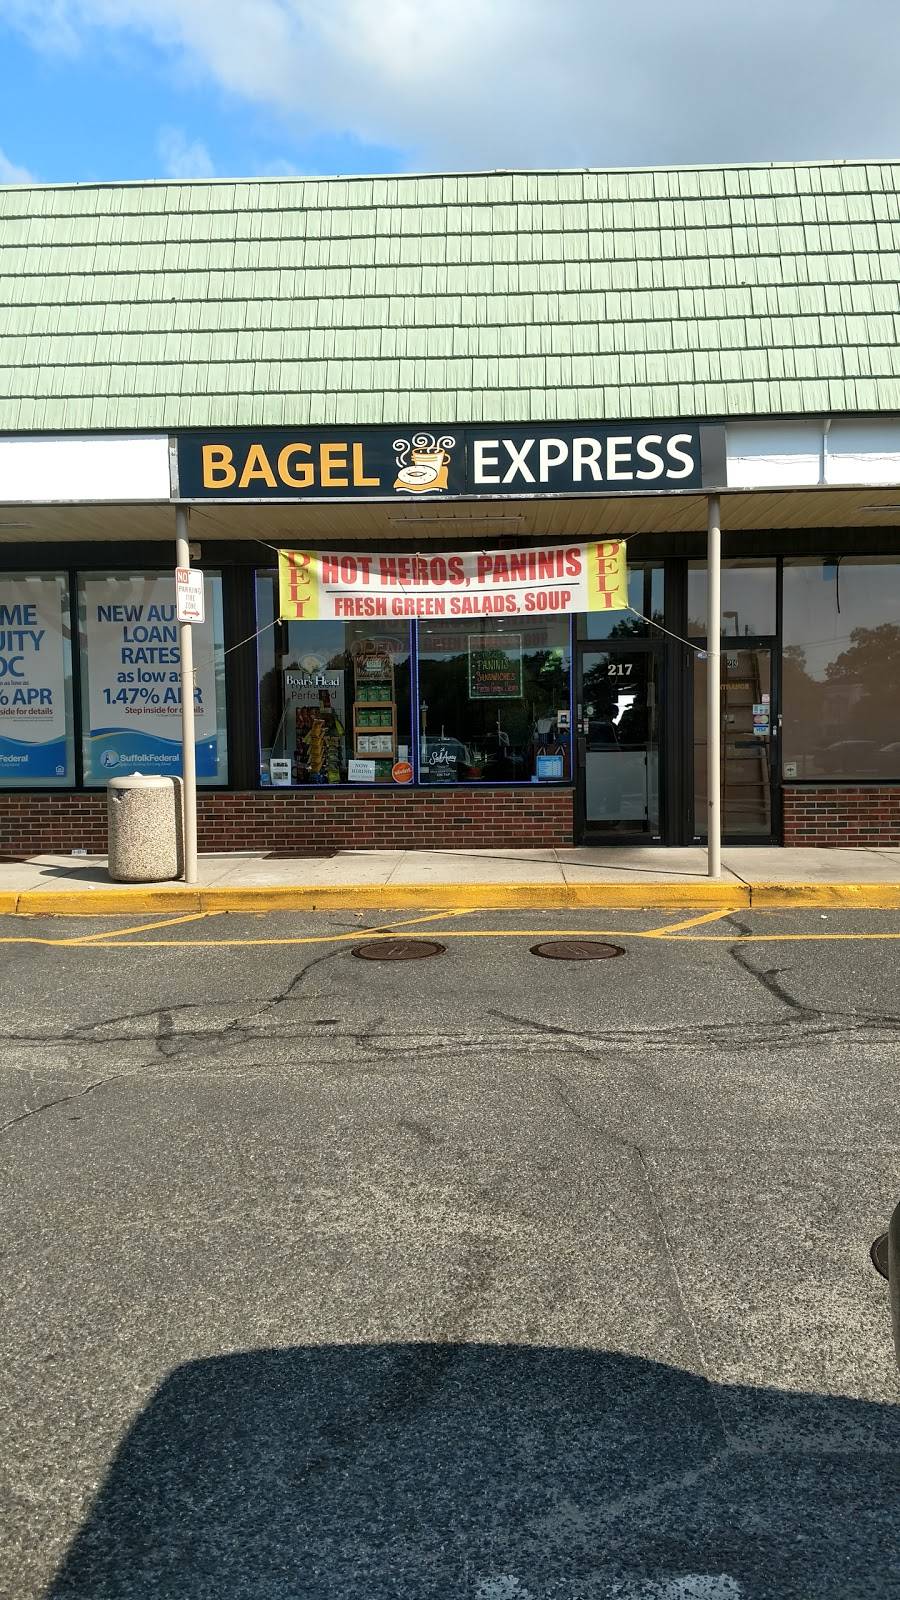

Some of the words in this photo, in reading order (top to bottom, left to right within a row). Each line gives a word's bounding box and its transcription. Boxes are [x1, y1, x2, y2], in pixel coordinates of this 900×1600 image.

[202, 442, 381, 489] BAGEL
[473, 434, 695, 484] EXPRESS
[321, 555, 373, 585] HOT
[379, 556, 470, 587] HEROS,
[477, 547, 582, 584] PANINIS
[177, 571, 188, 583] NO
[288, 551, 312, 618] DELI
[594, 543, 620, 609] DELI
[334, 597, 388, 617] FRESH
[391, 597, 446, 616] GREEN
[450, 593, 521, 615] SALADS,
[525, 591, 571, 612] SOUP
[97, 605, 144, 623] NEW
[123, 625, 177, 643] LOAN
[121, 647, 181, 664] RATES
[117, 672, 134, 683] as
[138, 668, 166, 683] low
[607, 664, 633, 676] 217
[315, 674, 340, 686] Head
[12, 688, 53, 705] APR
[103, 687, 160, 705] 1.47%
[16, 707, 28, 716] for
[28, 707, 53, 716] details
[125, 707, 143, 716] Step
[143, 706, 167, 714] inside
[167, 706, 179, 714] for
